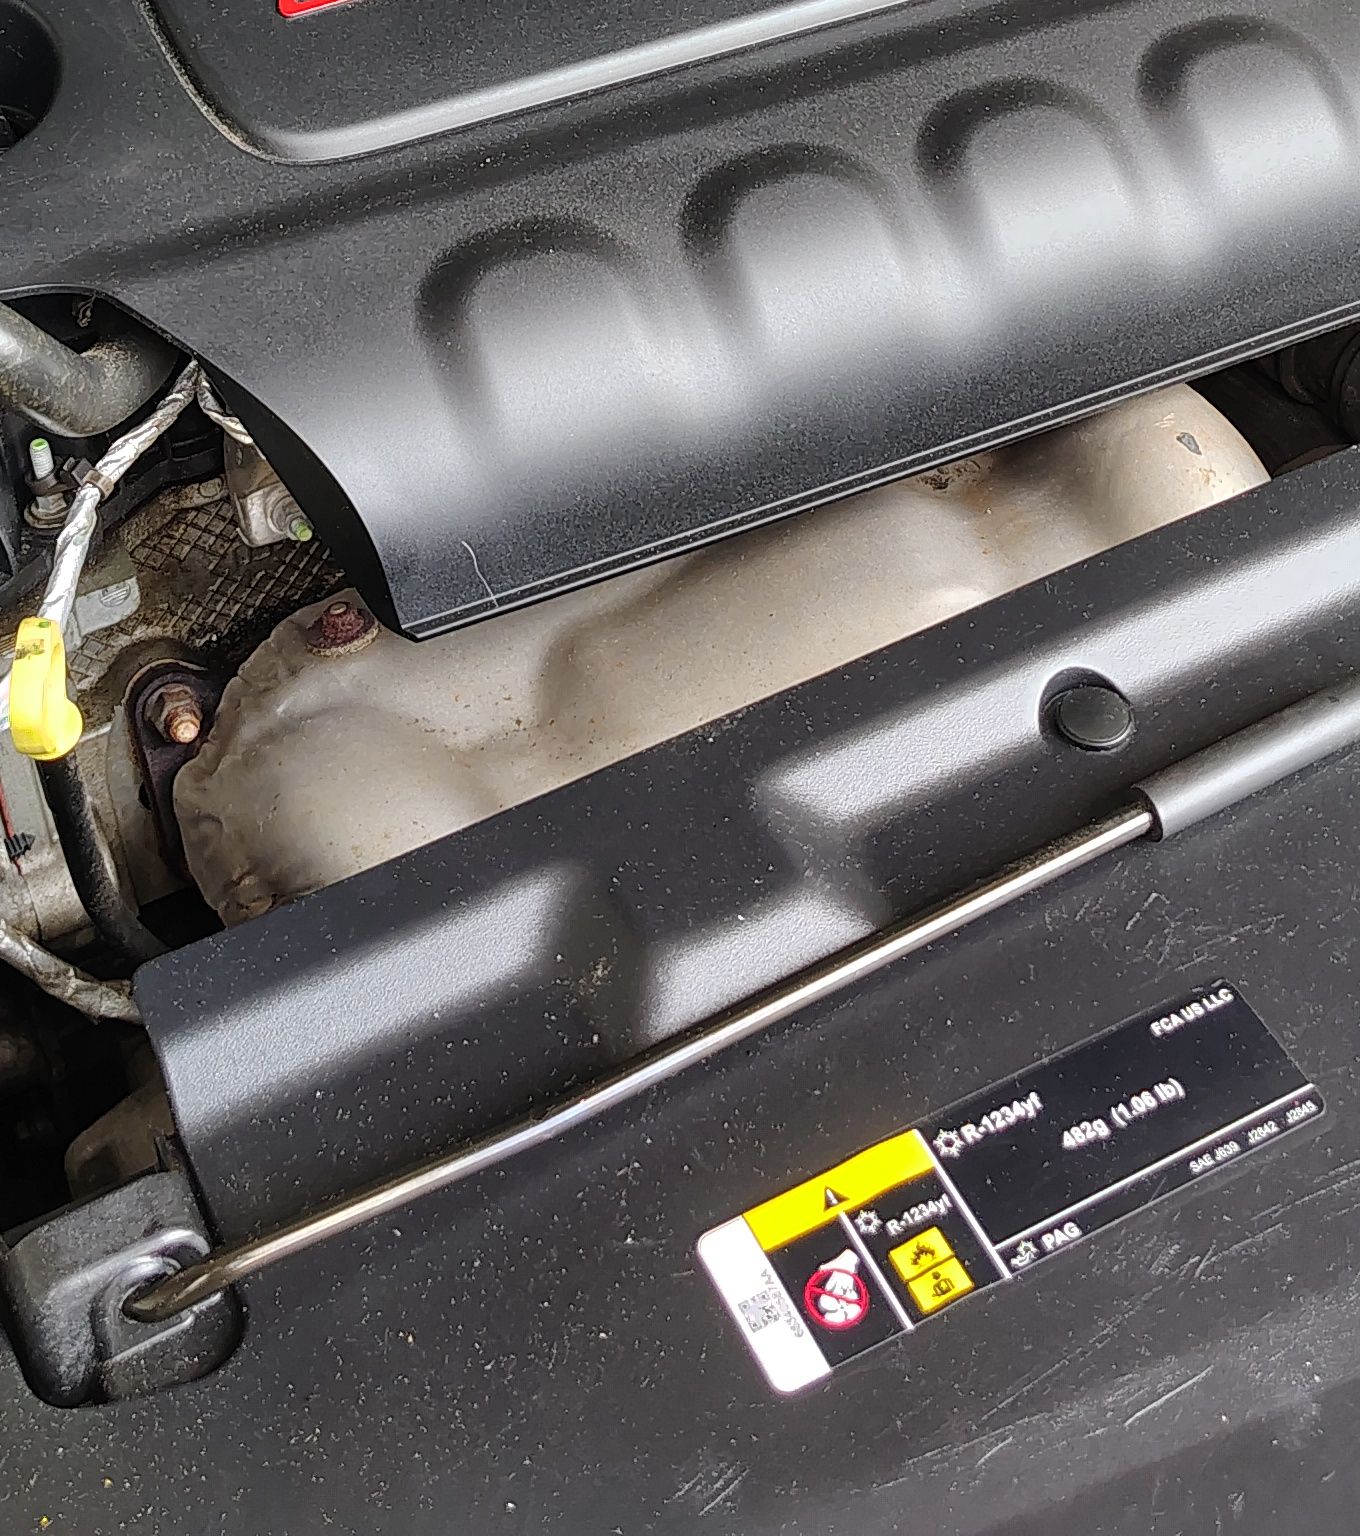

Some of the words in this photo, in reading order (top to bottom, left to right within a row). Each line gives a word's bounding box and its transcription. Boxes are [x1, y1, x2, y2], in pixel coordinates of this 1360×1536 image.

[1150, 1013, 1185, 1038] FCA
[1179, 1001, 1205, 1022] US
[1201, 987, 1235, 1012] LLC
[959, 1090, 1044, 1147] R-1234yf
[1061, 1117, 1111, 1150] 482g
[1110, 1091, 1159, 1128] (1.06
[1153, 1076, 1187, 1103] lb)
[1189, 1152, 1215, 1175] SAE
[1214, 1140, 1242, 1161] J639
[1246, 1120, 1281, 1145] J2842
[1285, 1099, 1320, 1124] J2845
[1041, 1221, 1083, 1251] PAG
